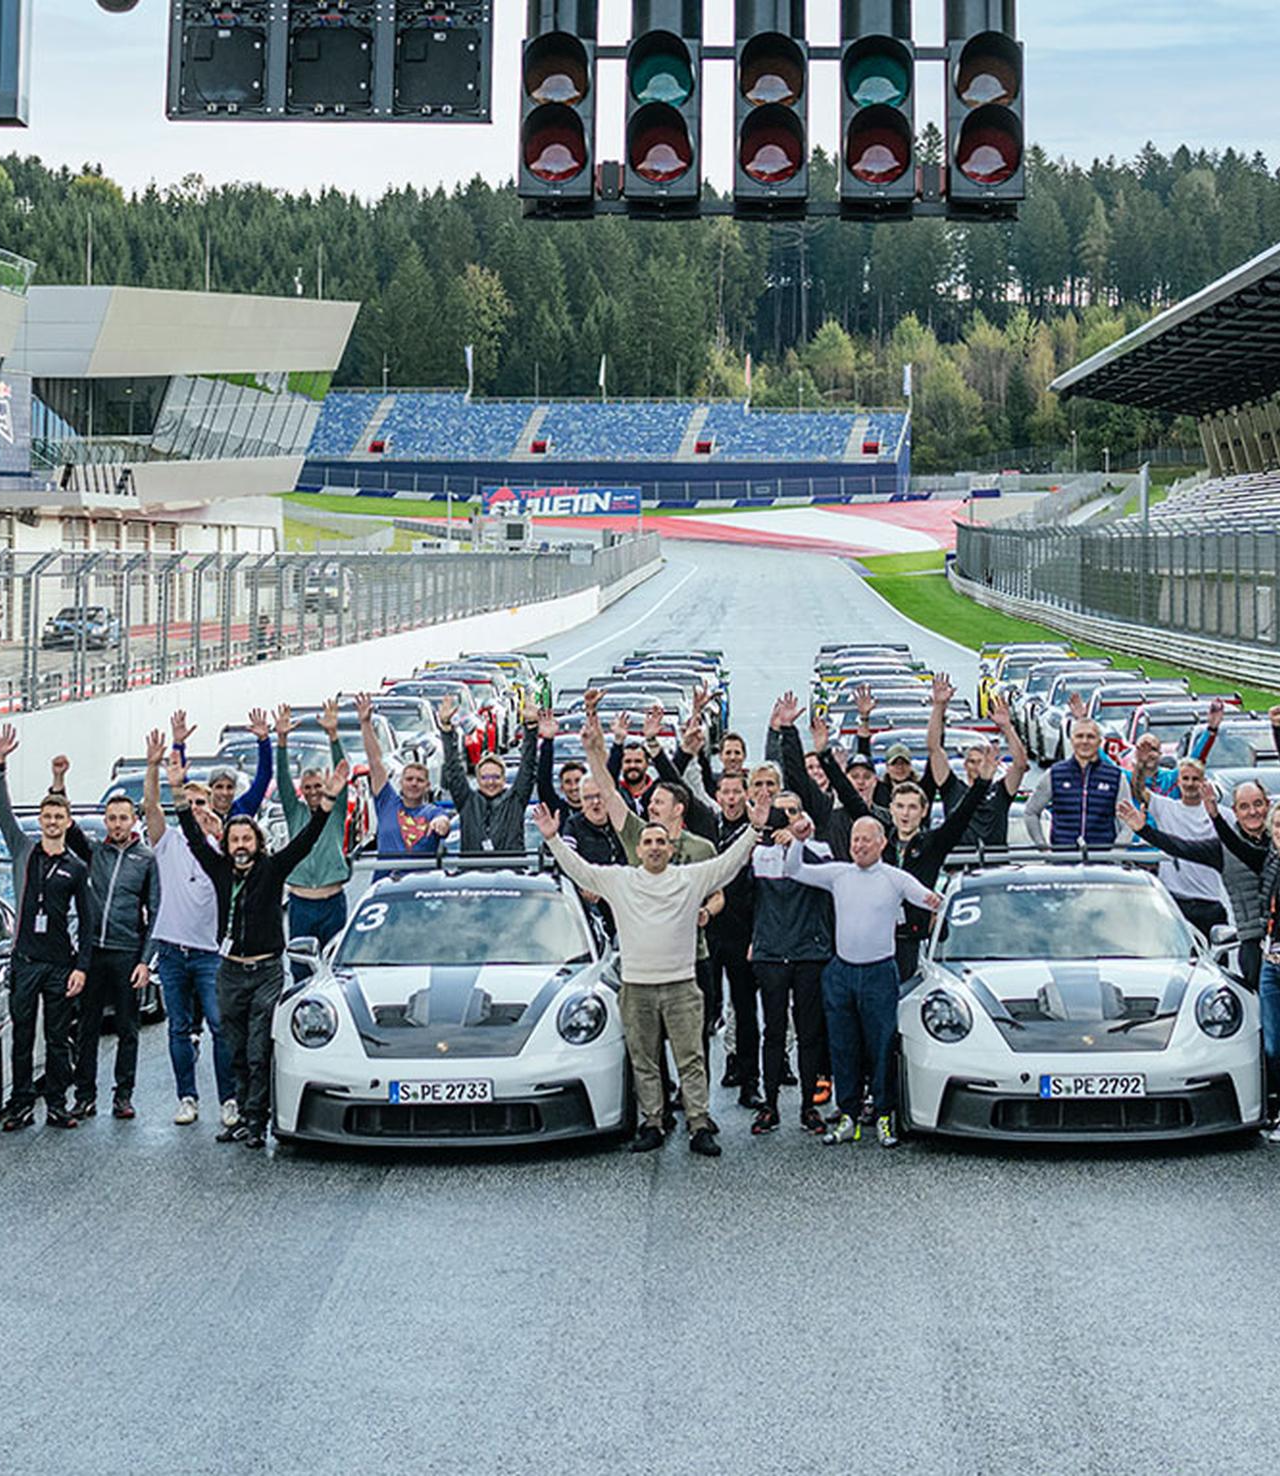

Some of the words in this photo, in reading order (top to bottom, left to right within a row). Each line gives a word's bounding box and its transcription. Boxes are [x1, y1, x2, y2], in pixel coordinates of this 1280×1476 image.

[414, 889, 459, 899] Porsche
[461, 888, 521, 898] Experience
[1006, 883, 1051, 892] Porsche
[354, 902, 389, 932] 3
[950, 895, 982, 927] 5
[400, 1084, 411, 1101] S
[420, 1084, 442, 1100] PE
[445, 1082, 488, 1100] 2733
[1052, 1078, 1063, 1095] S
[1074, 1078, 1095, 1095] PE
[1099, 1077, 1141, 1095] 2792
